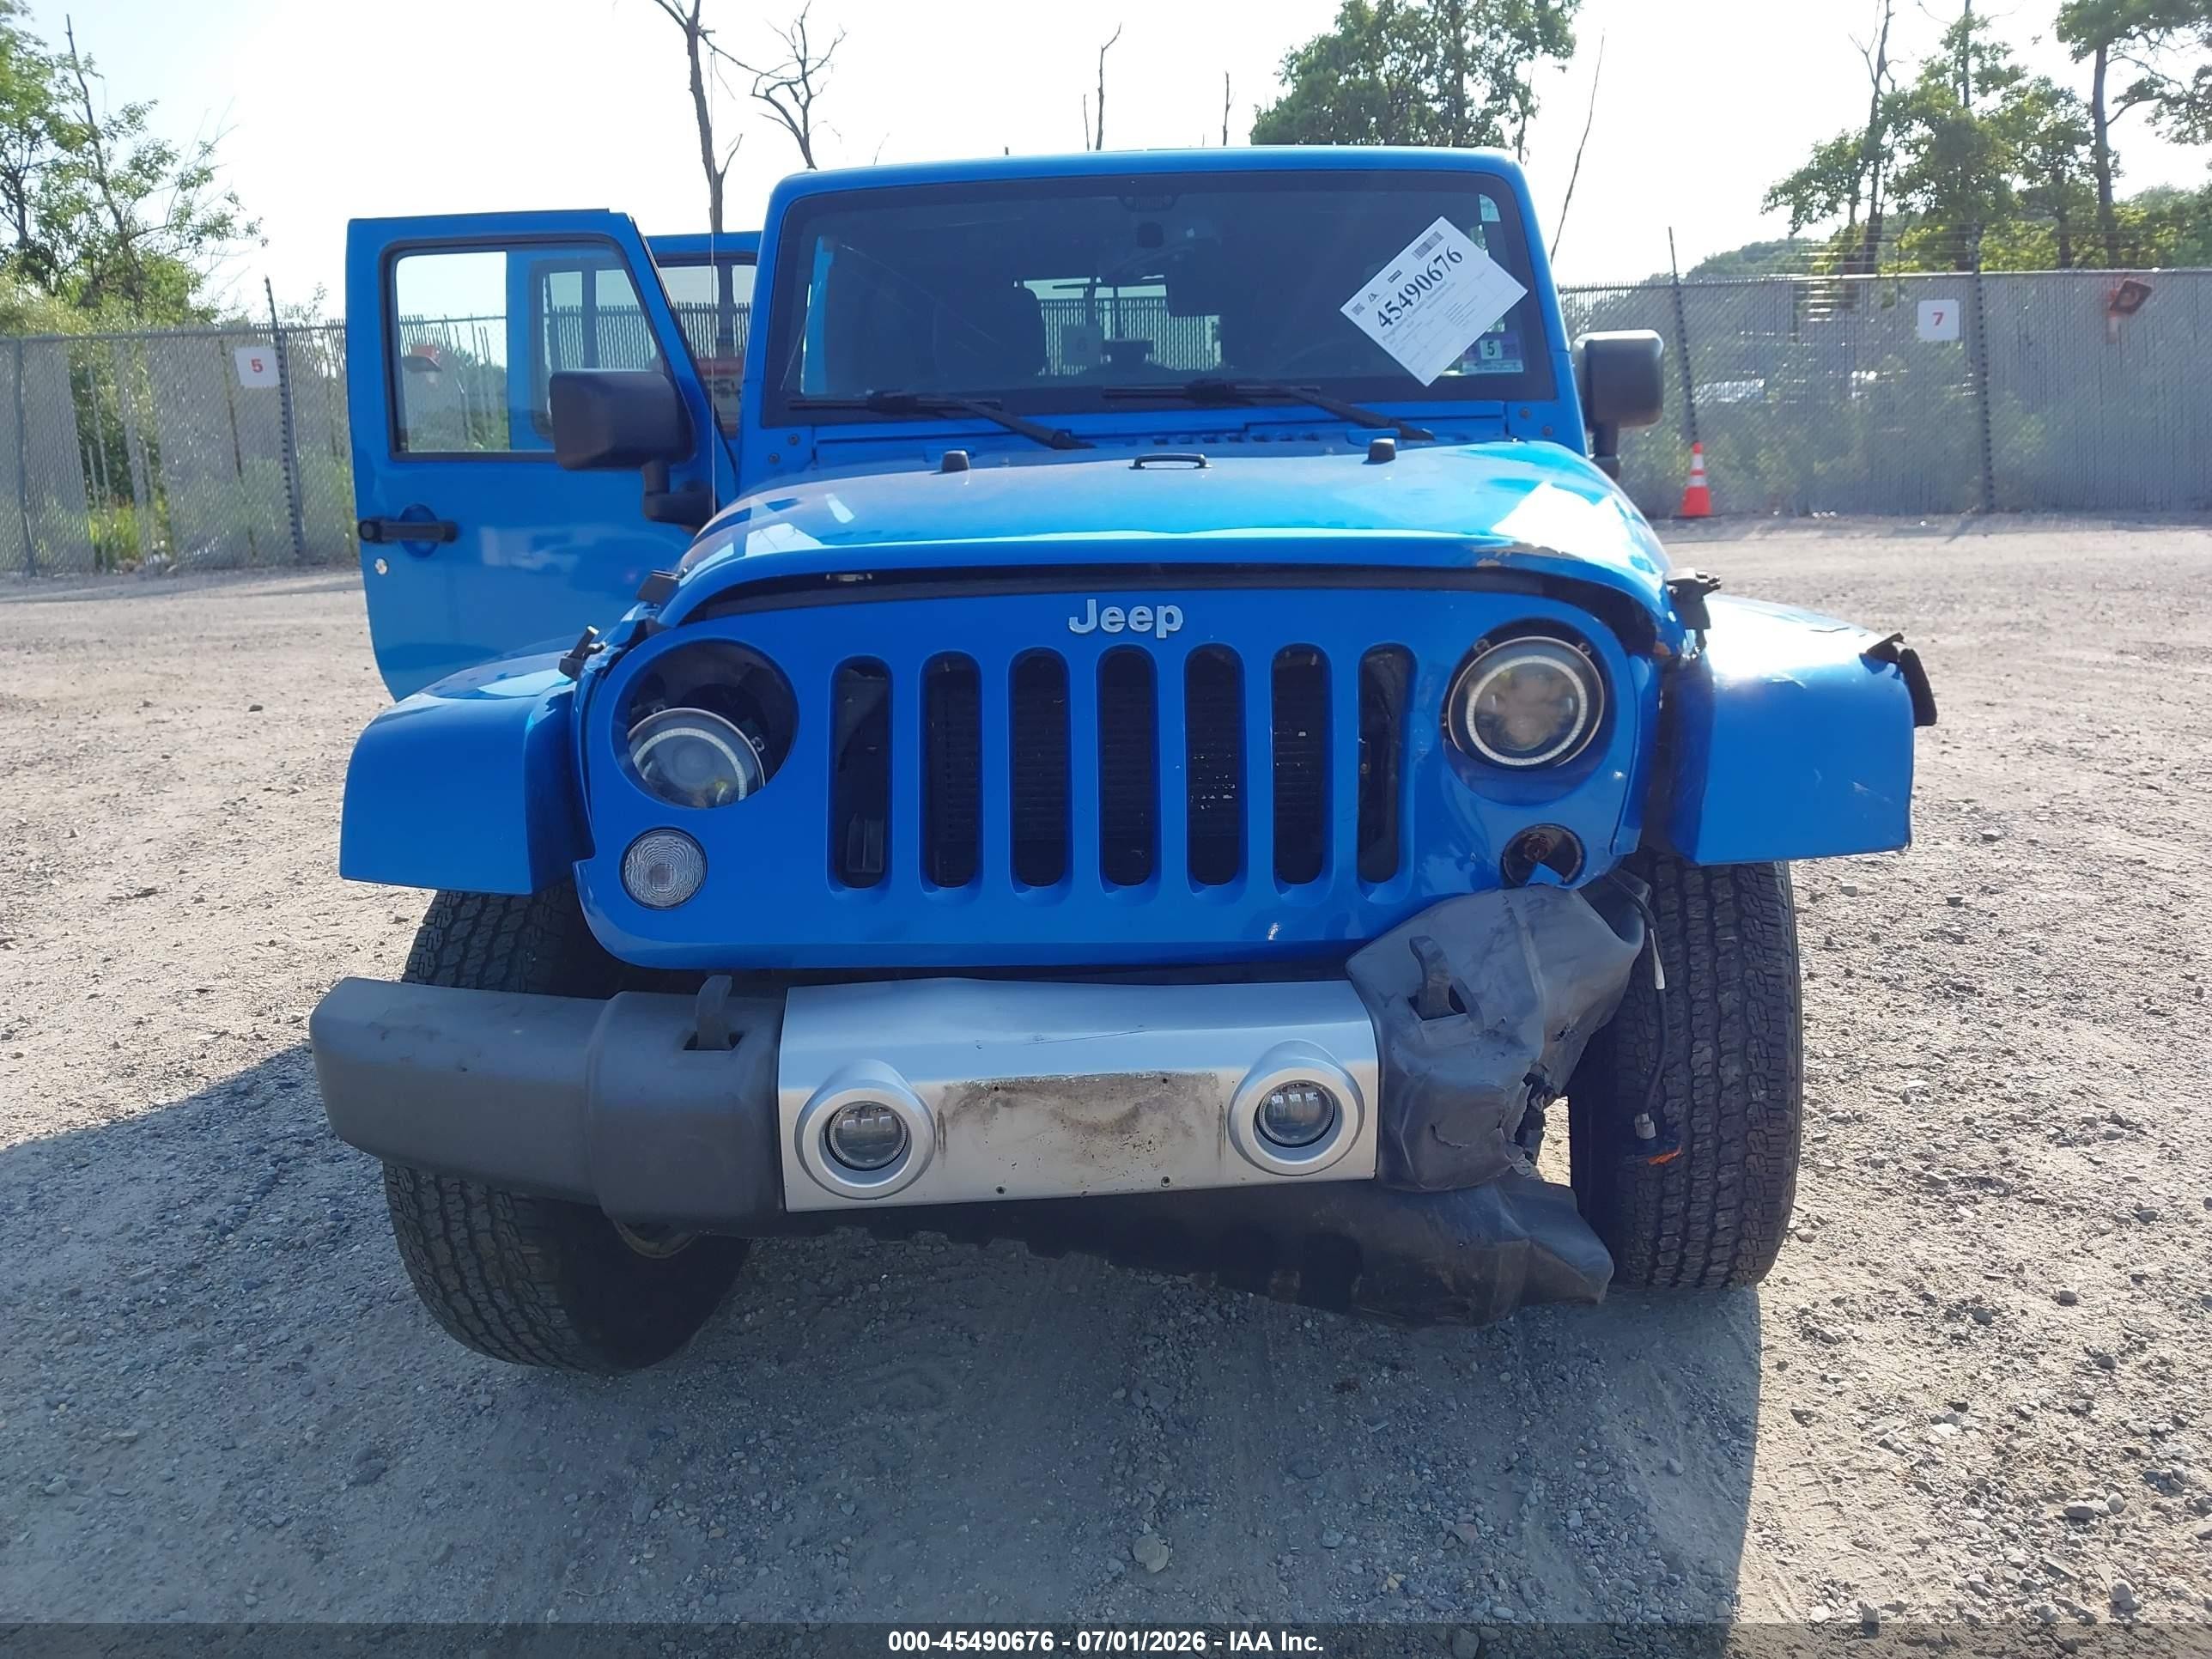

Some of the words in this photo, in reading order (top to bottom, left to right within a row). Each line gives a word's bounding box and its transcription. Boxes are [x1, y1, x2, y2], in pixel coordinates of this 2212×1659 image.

[1377, 245, 1463, 330] 45490676
[1932, 312, 1944, 326] 7
[1486, 340, 1495, 356] 5
[251, 357, 264, 373] 5
[1069, 599, 1183, 639] Jeep
